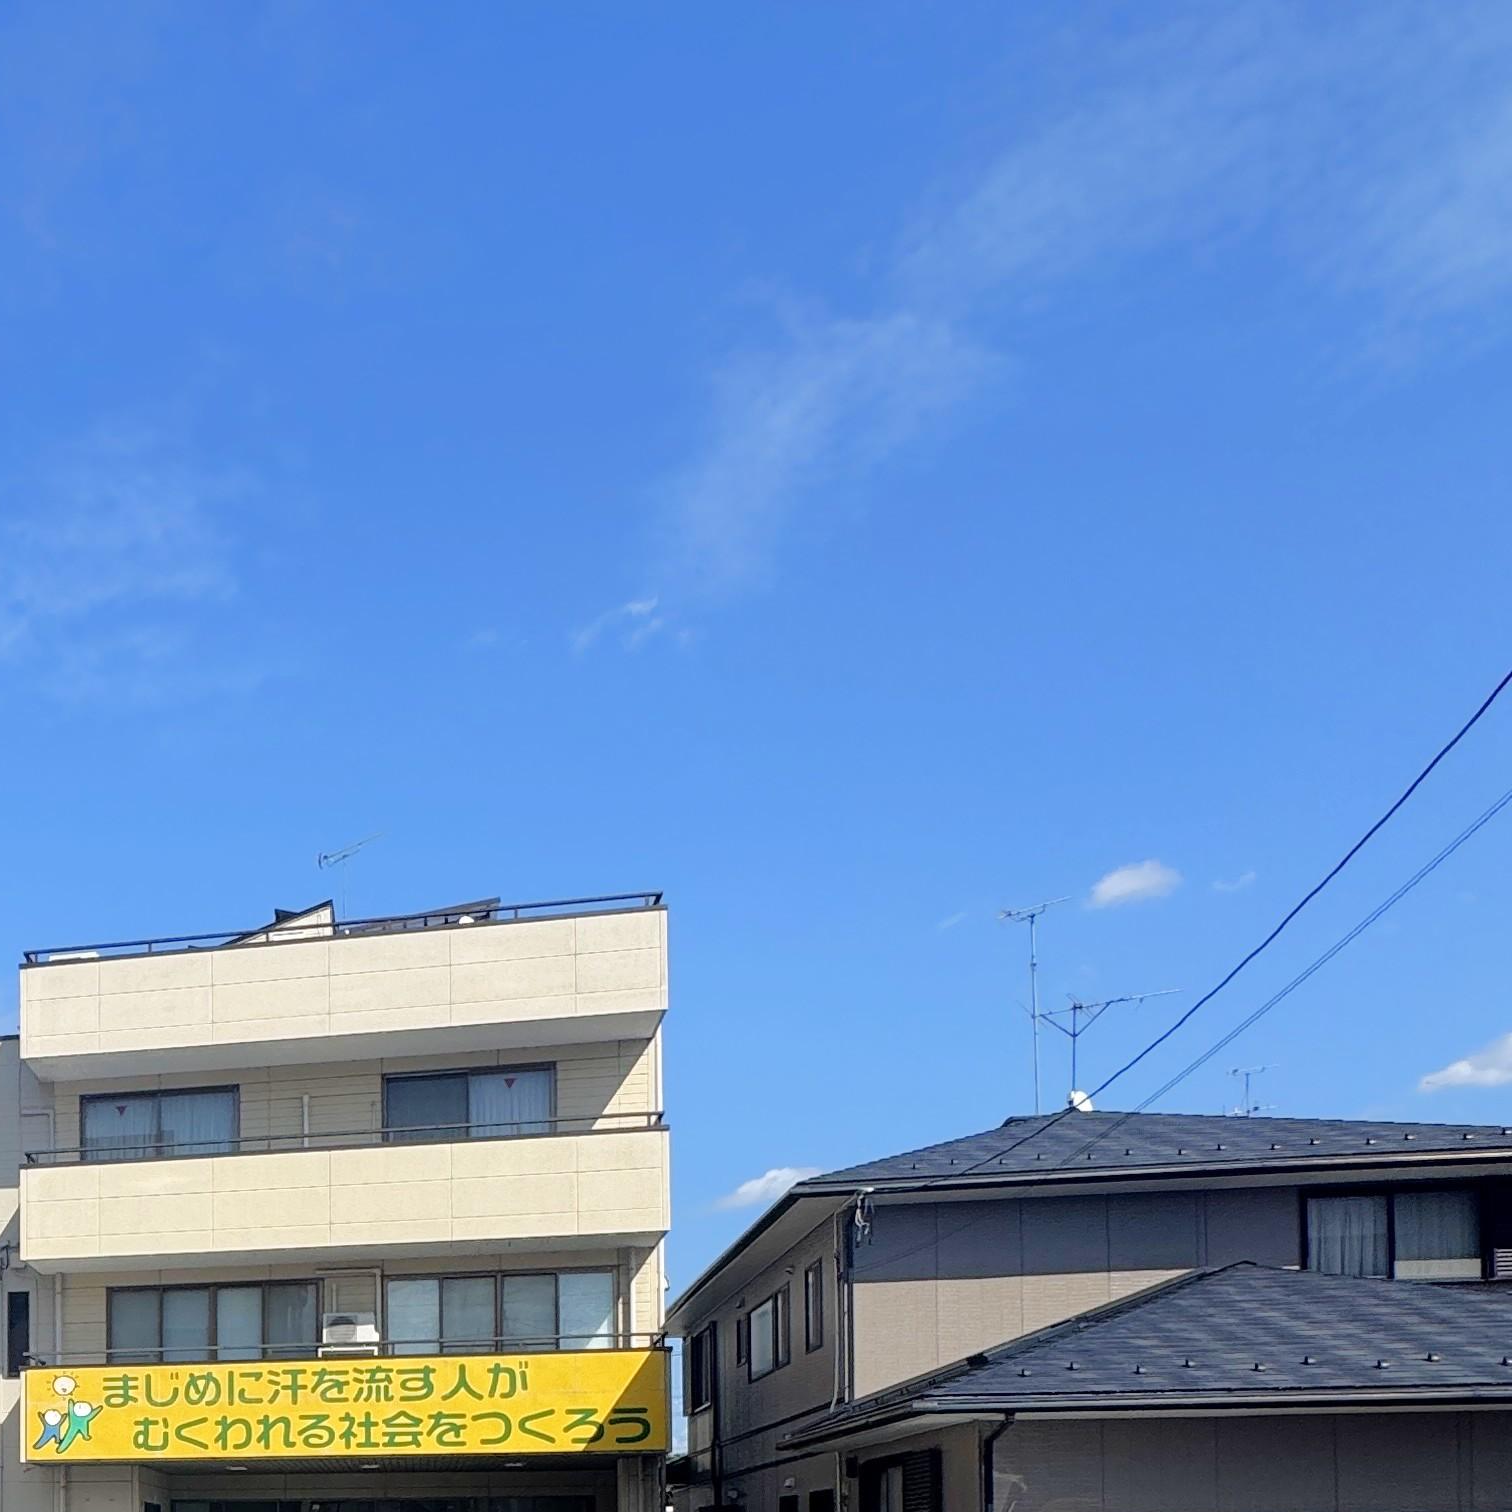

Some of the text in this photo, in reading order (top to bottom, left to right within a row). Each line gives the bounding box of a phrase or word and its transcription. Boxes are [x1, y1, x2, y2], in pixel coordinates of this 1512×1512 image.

[102, 1360, 529, 1409] まじめに汗を流す人が
[132, 1407, 651, 1451] むくわれる社会をつくろう
